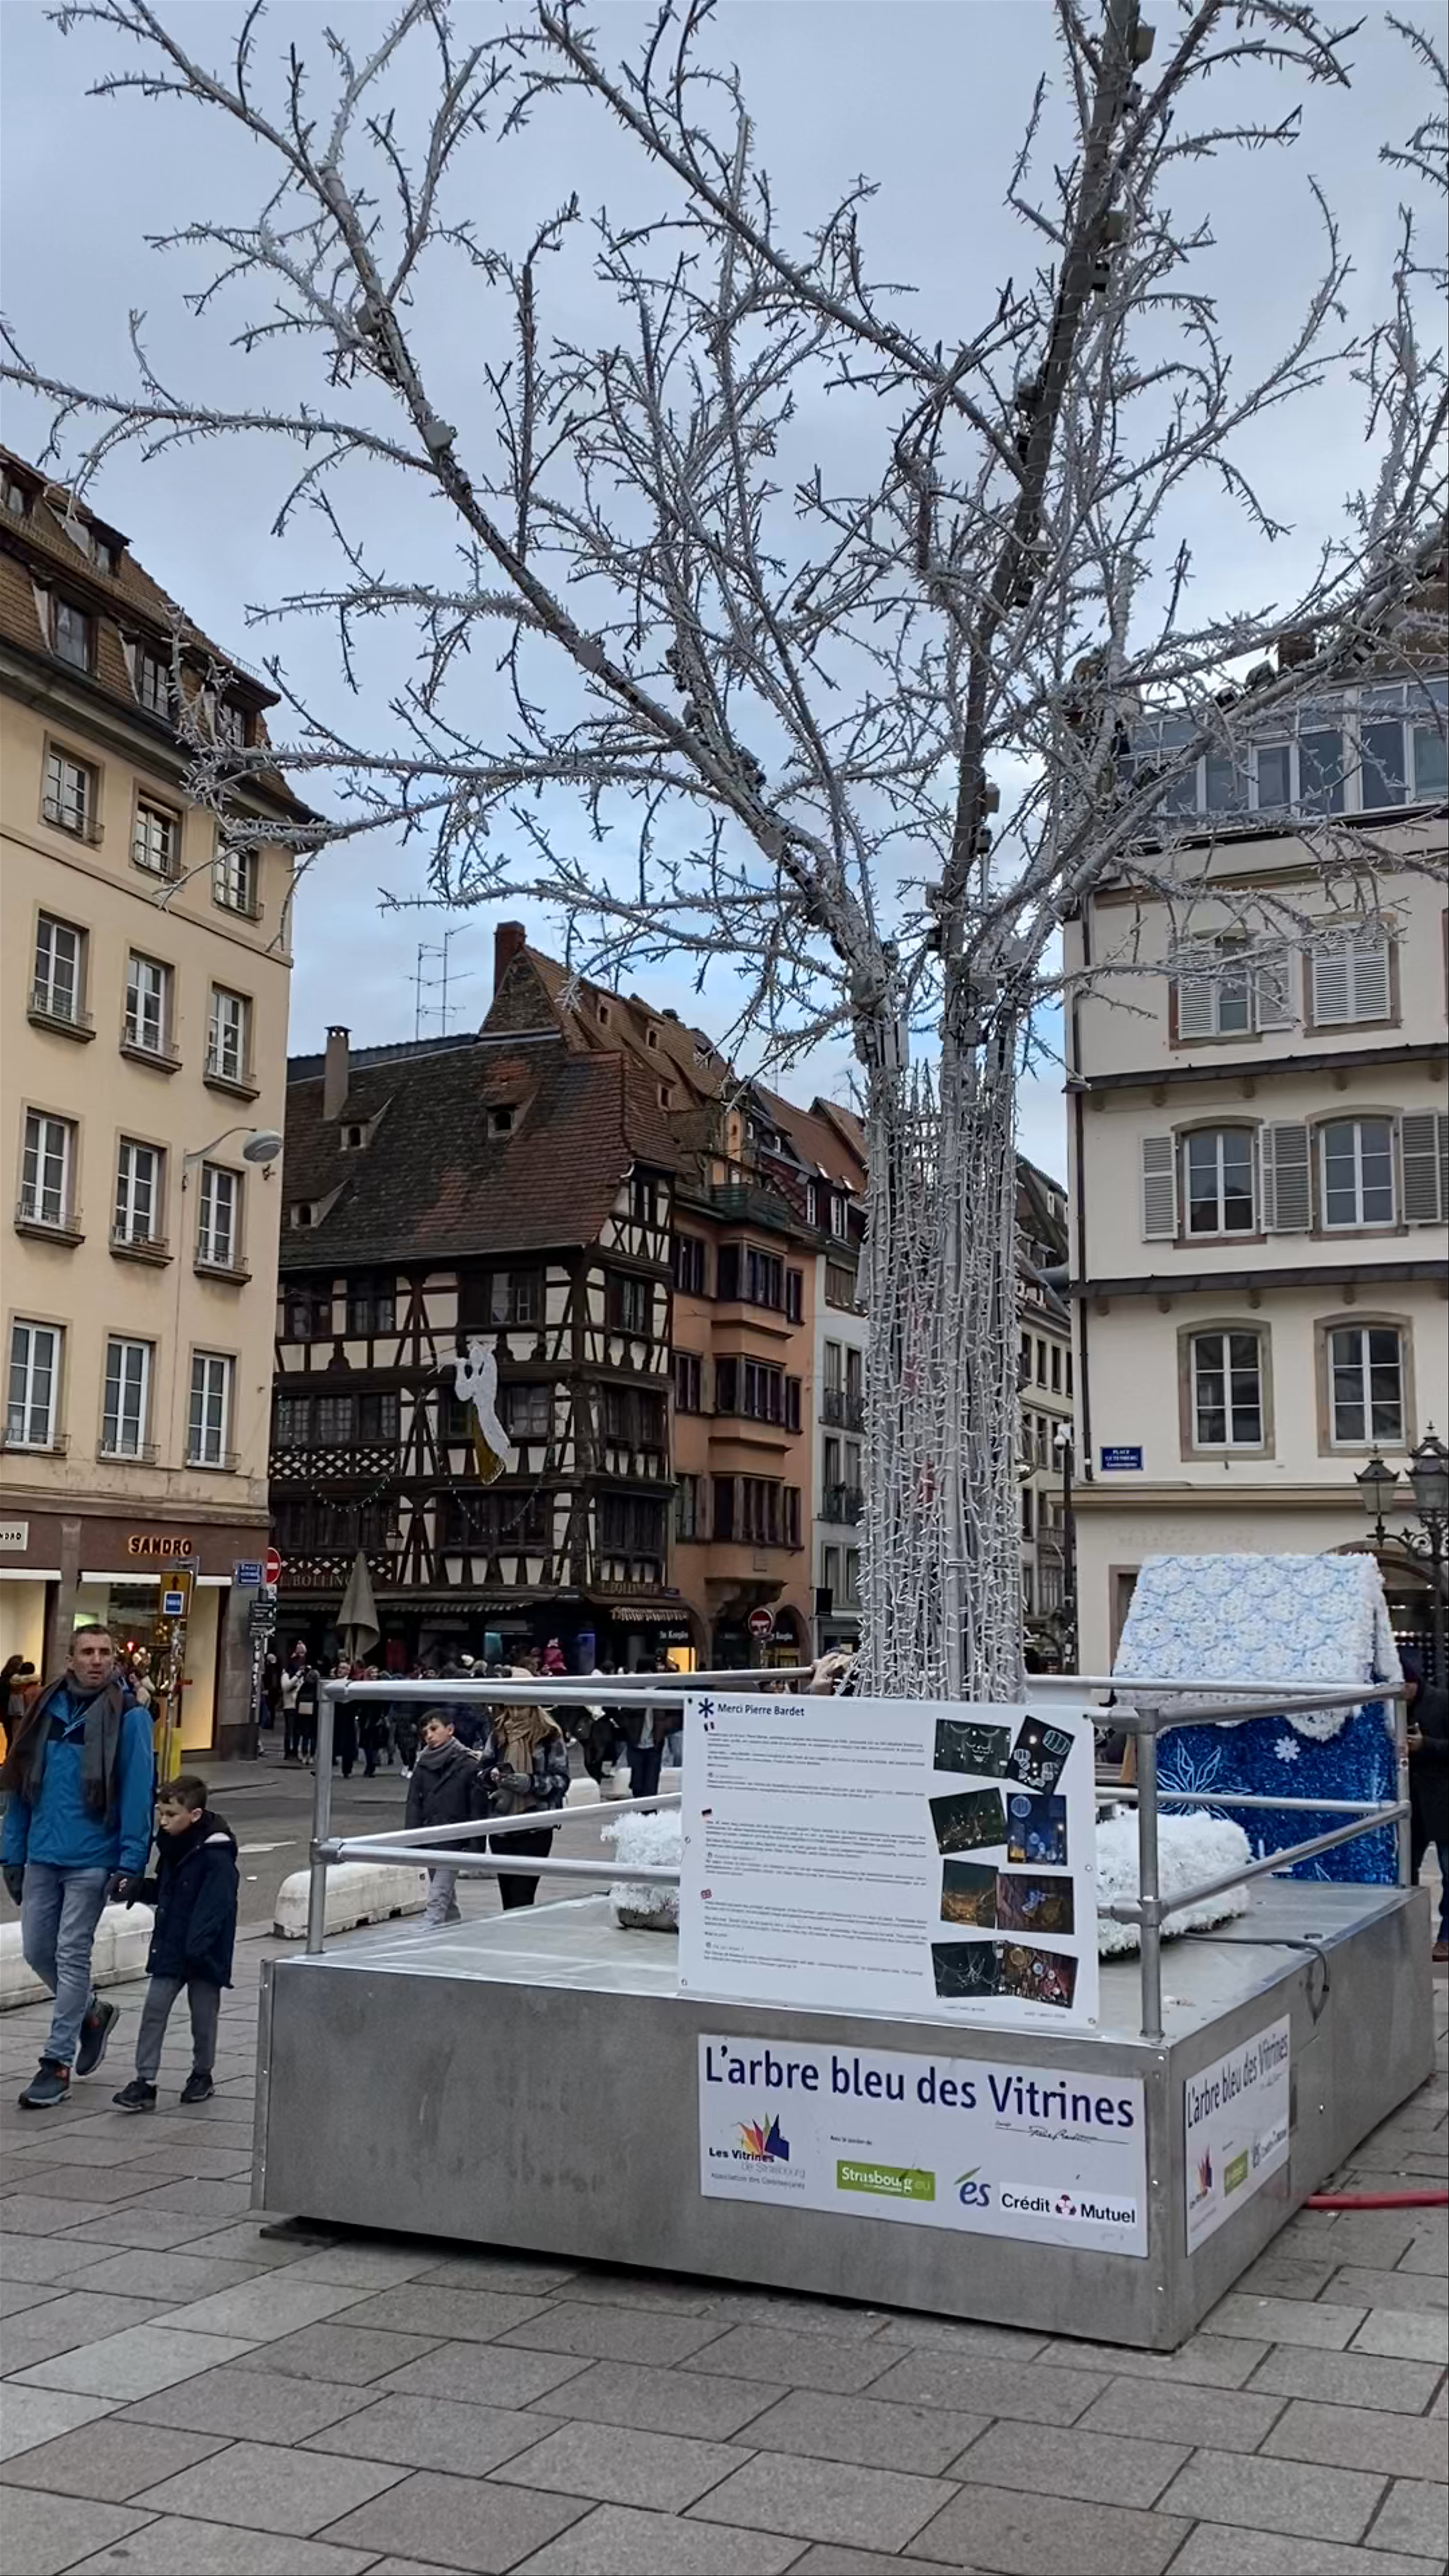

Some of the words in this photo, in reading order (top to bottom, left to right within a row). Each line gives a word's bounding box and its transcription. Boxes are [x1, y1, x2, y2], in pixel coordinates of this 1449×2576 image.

[131, 1536, 192, 1555] SANDRO
[718, 1703, 743, 1713] Merci
[745, 1704, 771, 1715] Pierre
[774, 1706, 804, 1716] Bardet
[706, 2045, 819, 2090] L'arbre
[832, 2056, 904, 2101] bleu
[917, 2066, 977, 2109] des
[988, 2075, 1134, 2127] Vitrines
[1188, 2079, 1219, 2128] L'arbre
[1244, 2051, 1257, 2087] des
[709, 2147, 729, 2158] Les
[732, 2150, 774, 2163] Vitrines
[1001, 2193, 1051, 2212] Crédit
[1081, 2203, 1135, 2223] Mutuel
